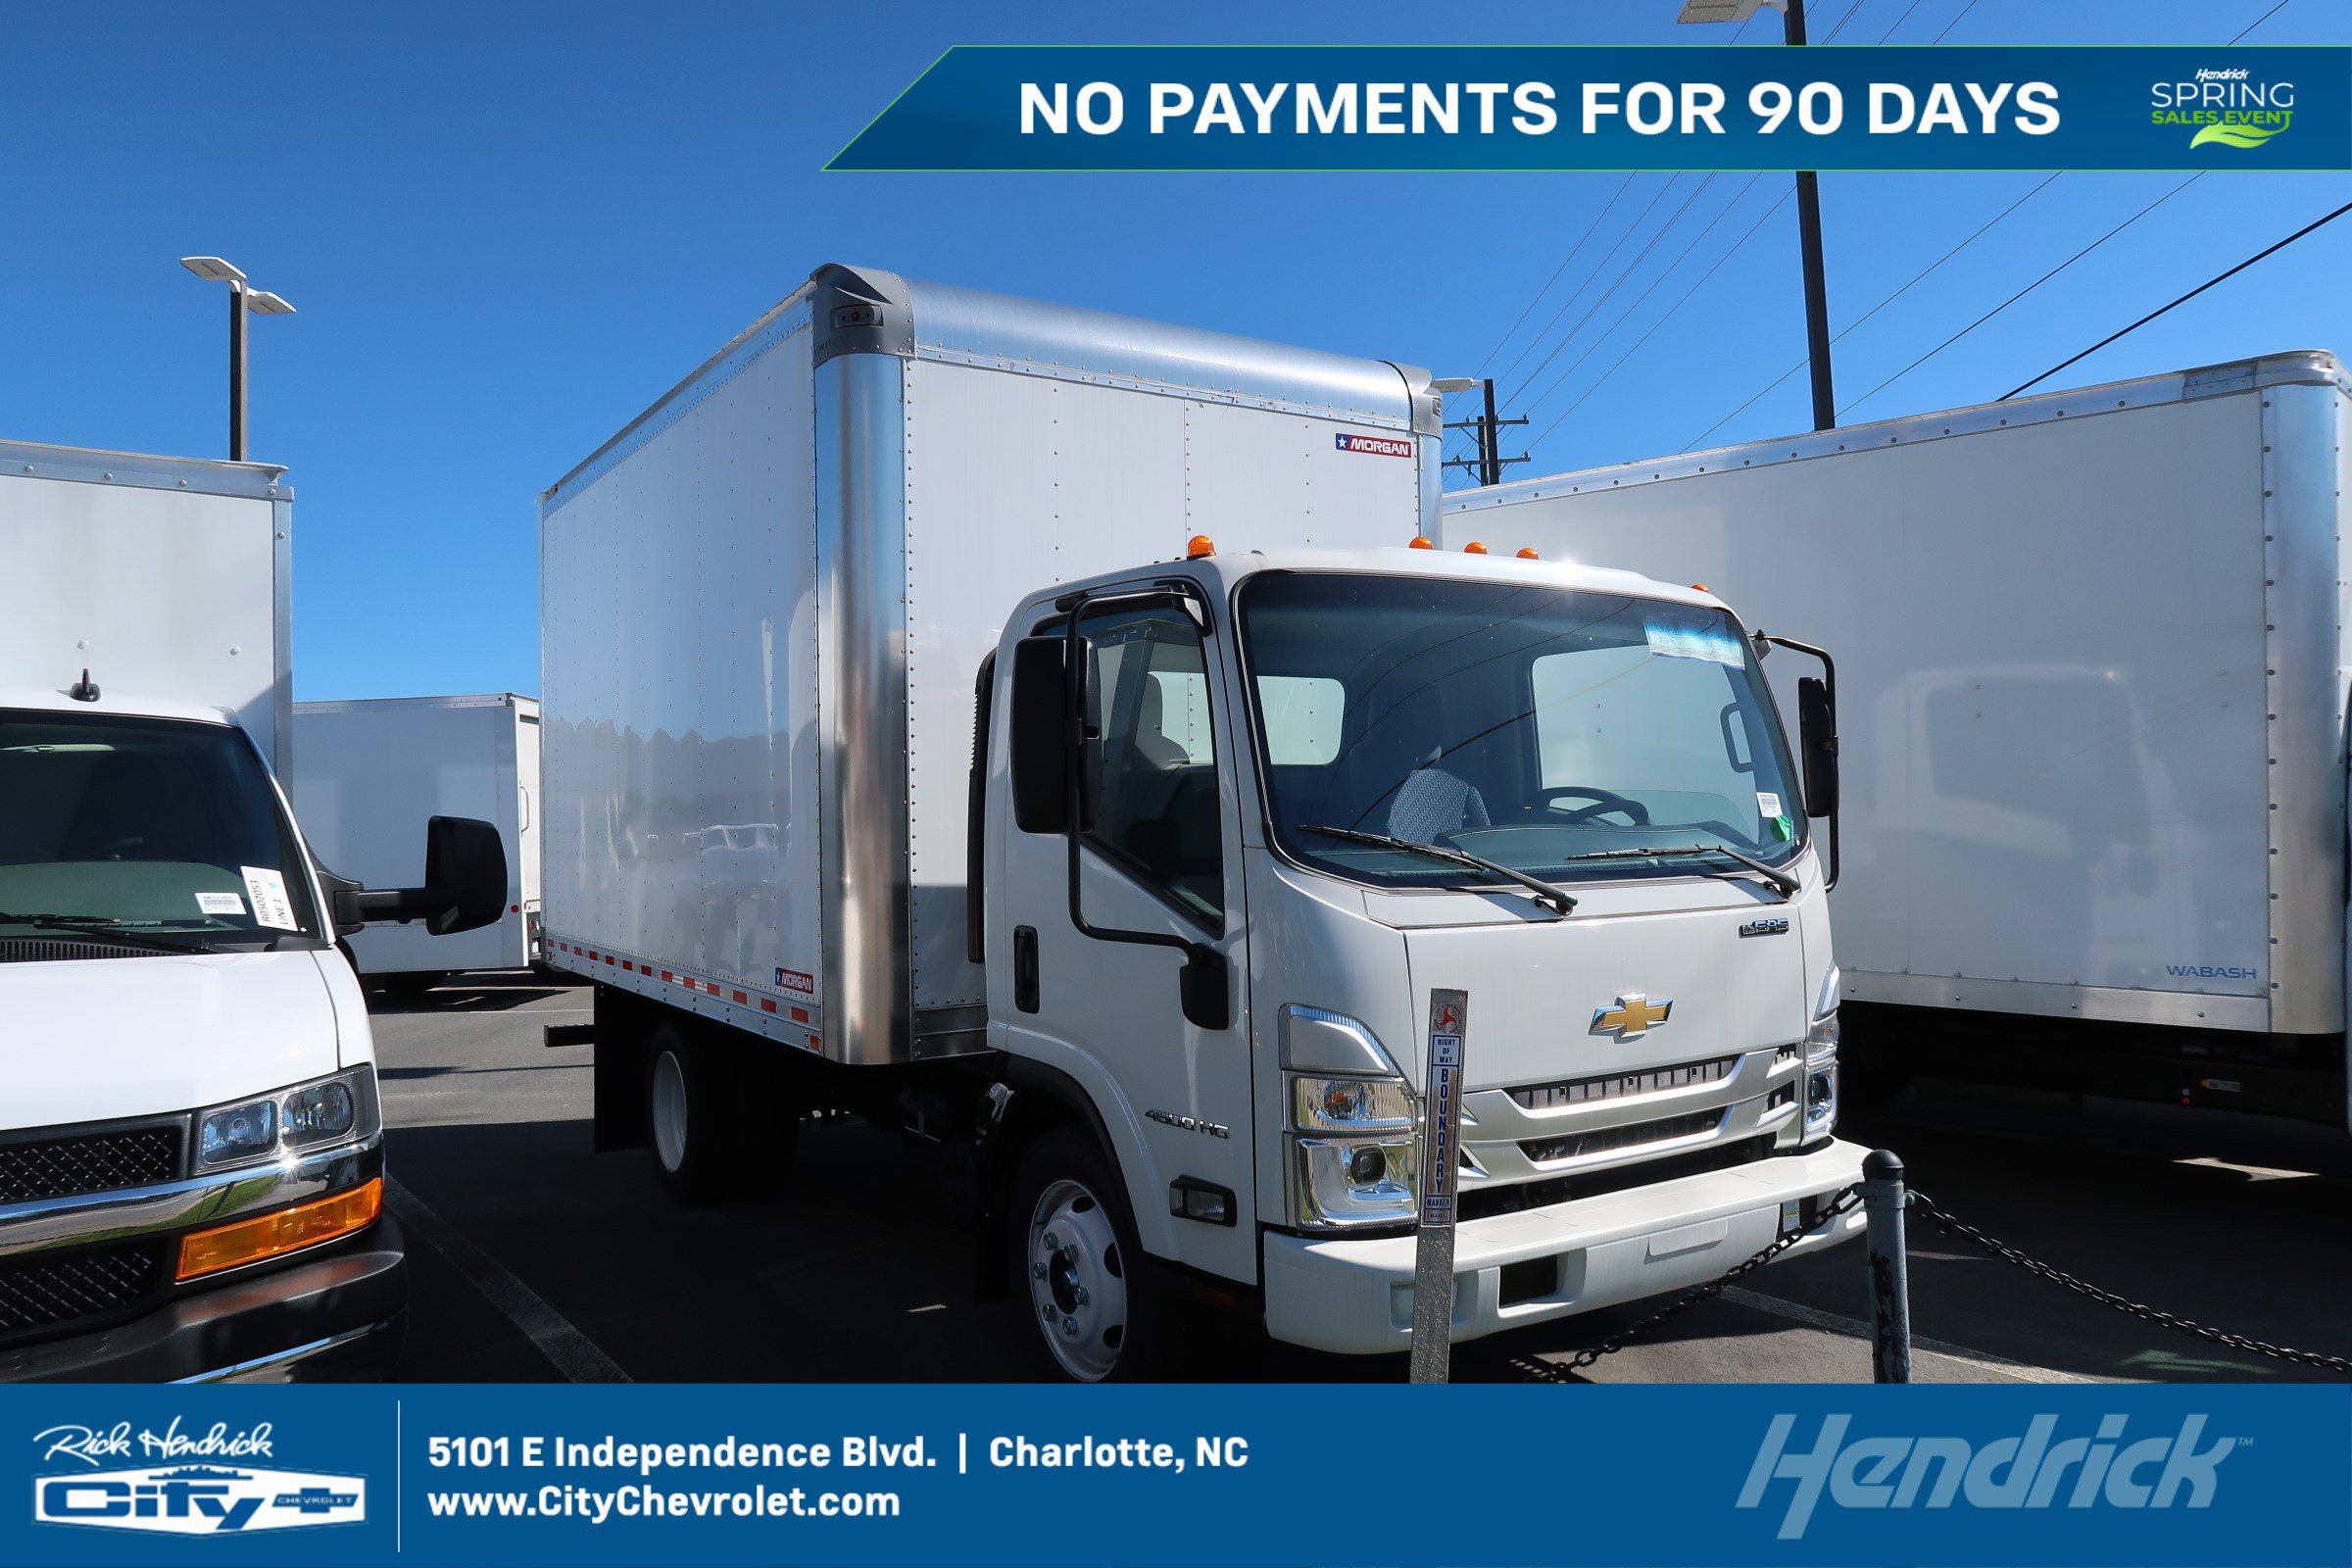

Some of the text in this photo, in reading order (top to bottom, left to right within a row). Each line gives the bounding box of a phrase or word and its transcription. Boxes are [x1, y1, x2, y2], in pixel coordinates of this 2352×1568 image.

[1350, 438, 1409, 456] MORGAN
[781, 972, 812, 991] MORGAN
[2166, 964, 2257, 980] WABASH
[1200, 1120, 1230, 1139] HG
[1436, 1068, 1449, 1194] BOUNDARY
